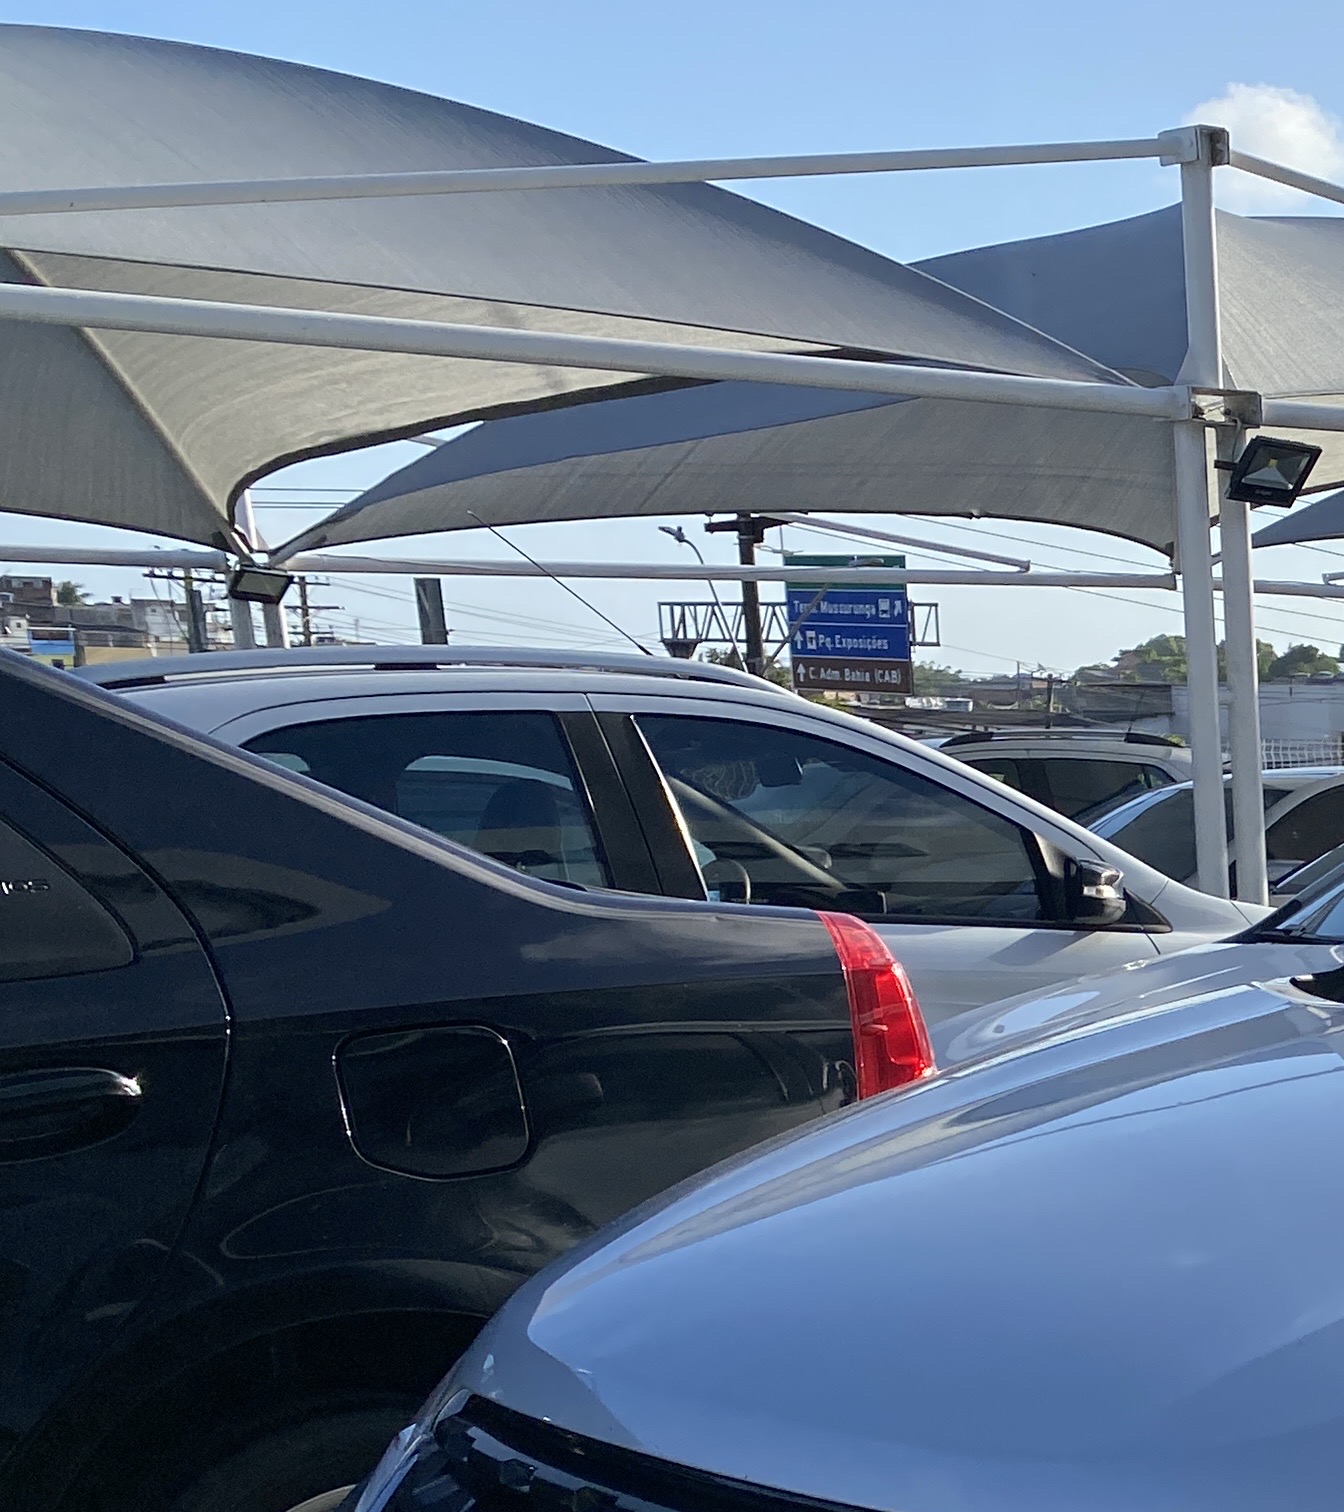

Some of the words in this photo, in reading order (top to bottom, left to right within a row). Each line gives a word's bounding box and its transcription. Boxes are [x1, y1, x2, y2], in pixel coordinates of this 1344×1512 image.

[834, 634, 889, 650] Exposições
[844, 667, 870, 682] Bahia
[874, 668, 901, 685] (CAB)
